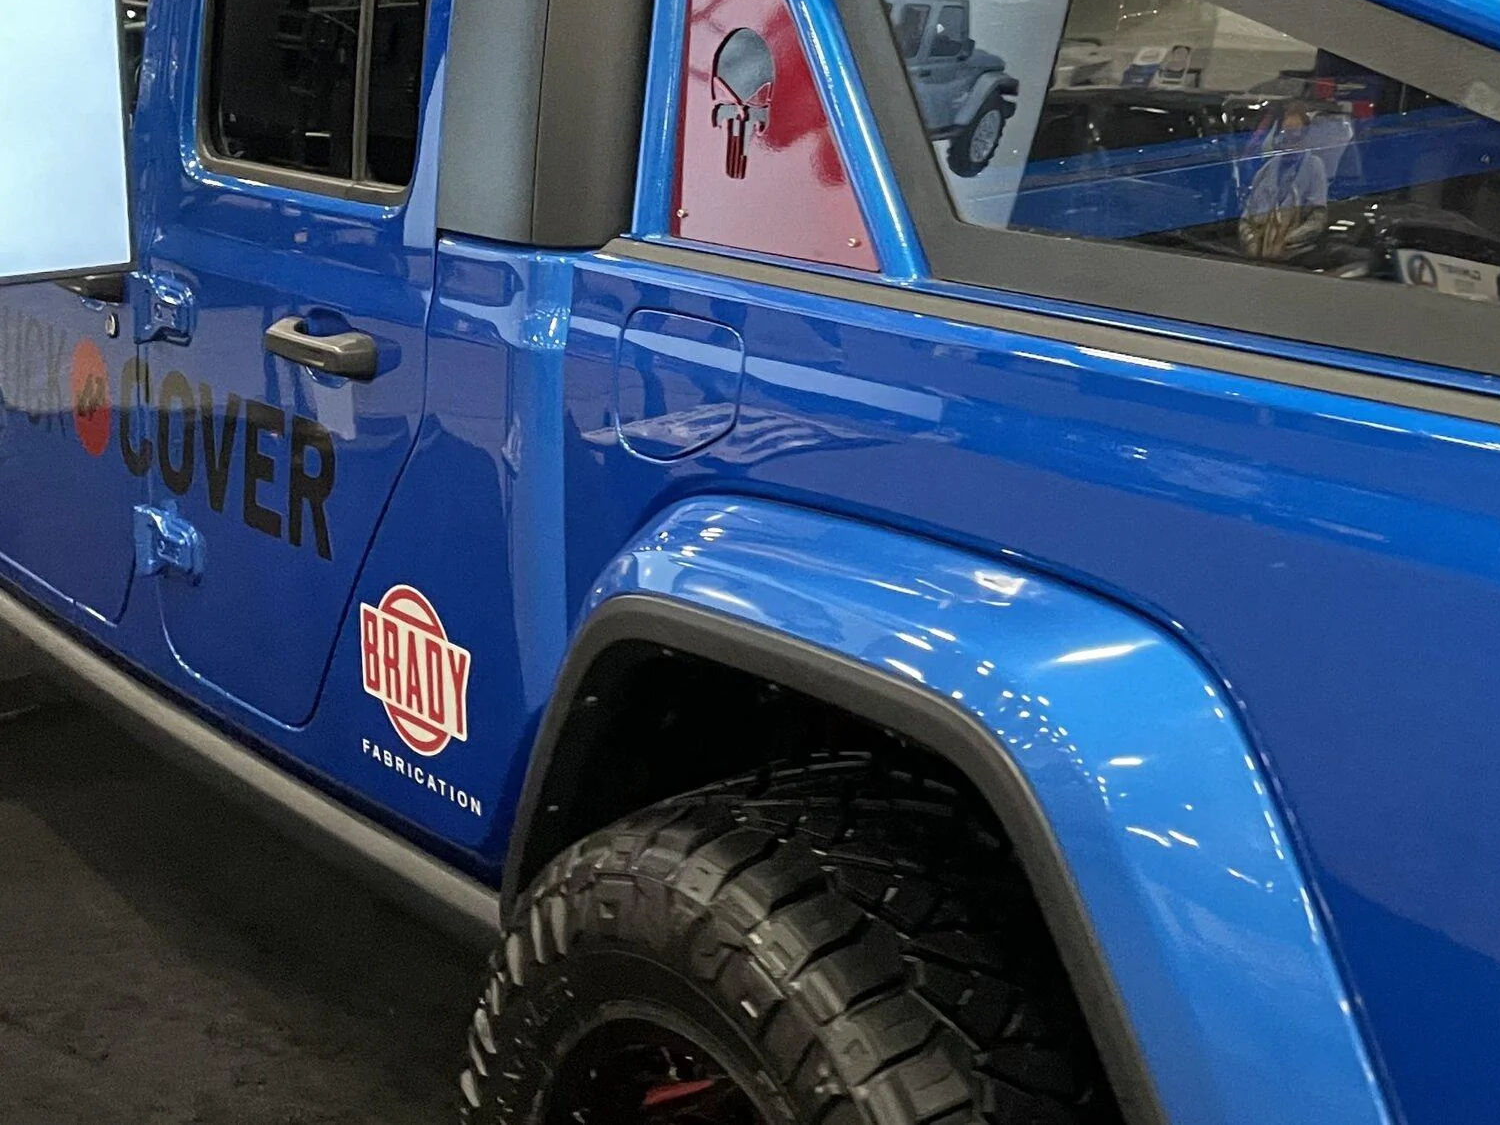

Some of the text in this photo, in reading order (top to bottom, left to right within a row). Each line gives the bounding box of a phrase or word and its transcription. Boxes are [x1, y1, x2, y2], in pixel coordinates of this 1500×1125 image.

[119, 355, 337, 562] COVER
[363, 608, 467, 736] BRADY
[362, 738, 482, 817] FABRICATION
